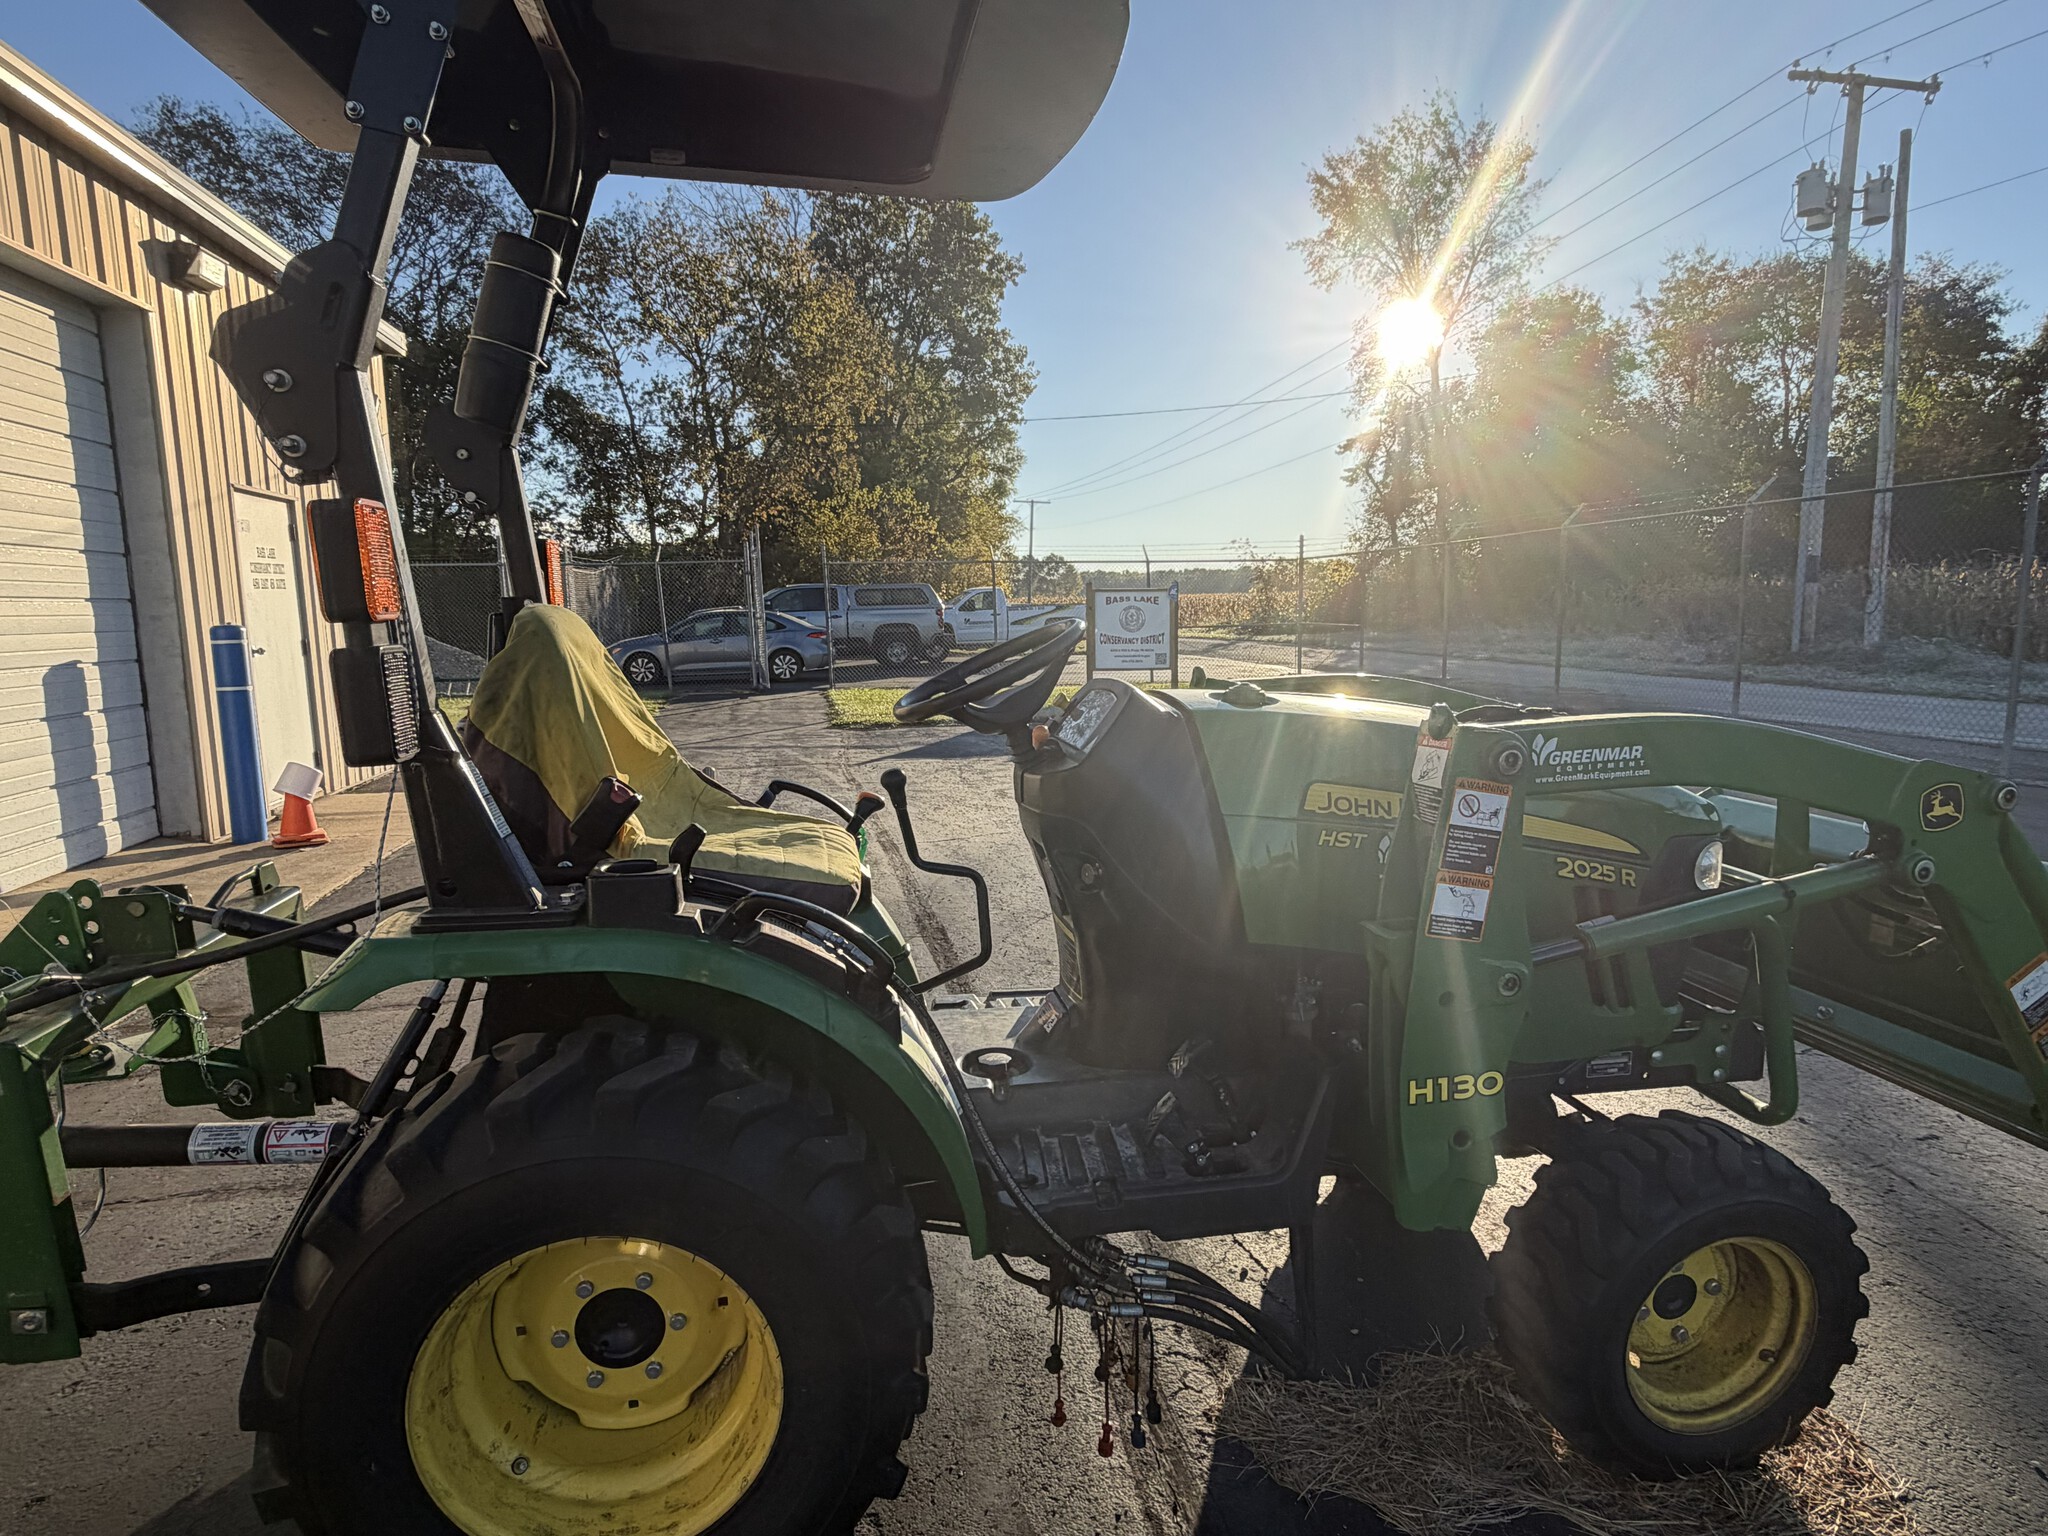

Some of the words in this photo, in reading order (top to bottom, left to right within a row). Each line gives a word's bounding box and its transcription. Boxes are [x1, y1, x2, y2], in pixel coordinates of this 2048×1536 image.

[1105, 596, 1131, 605] BASS
[1133, 596, 1159, 605] LAKE
[1100, 632, 1139, 645] CONSERVANCY
[1140, 632, 1165, 645] DISTRICT
[1549, 745, 1643, 765] GREENMAR
[1556, 760, 1645, 773] EQUIPMENT
[1535, 769, 1650, 783] www.GreenMarkEquipment.com
[1466, 780, 1509, 794] WARNING
[1318, 792, 1392, 817] JOHN
[1318, 830, 1368, 849] HST
[1556, 857, 1616, 882] 2025
[1621, 868, 1637, 887] R
[1447, 874, 1490, 888] WARNING
[1408, 1071, 1504, 1105] H130
